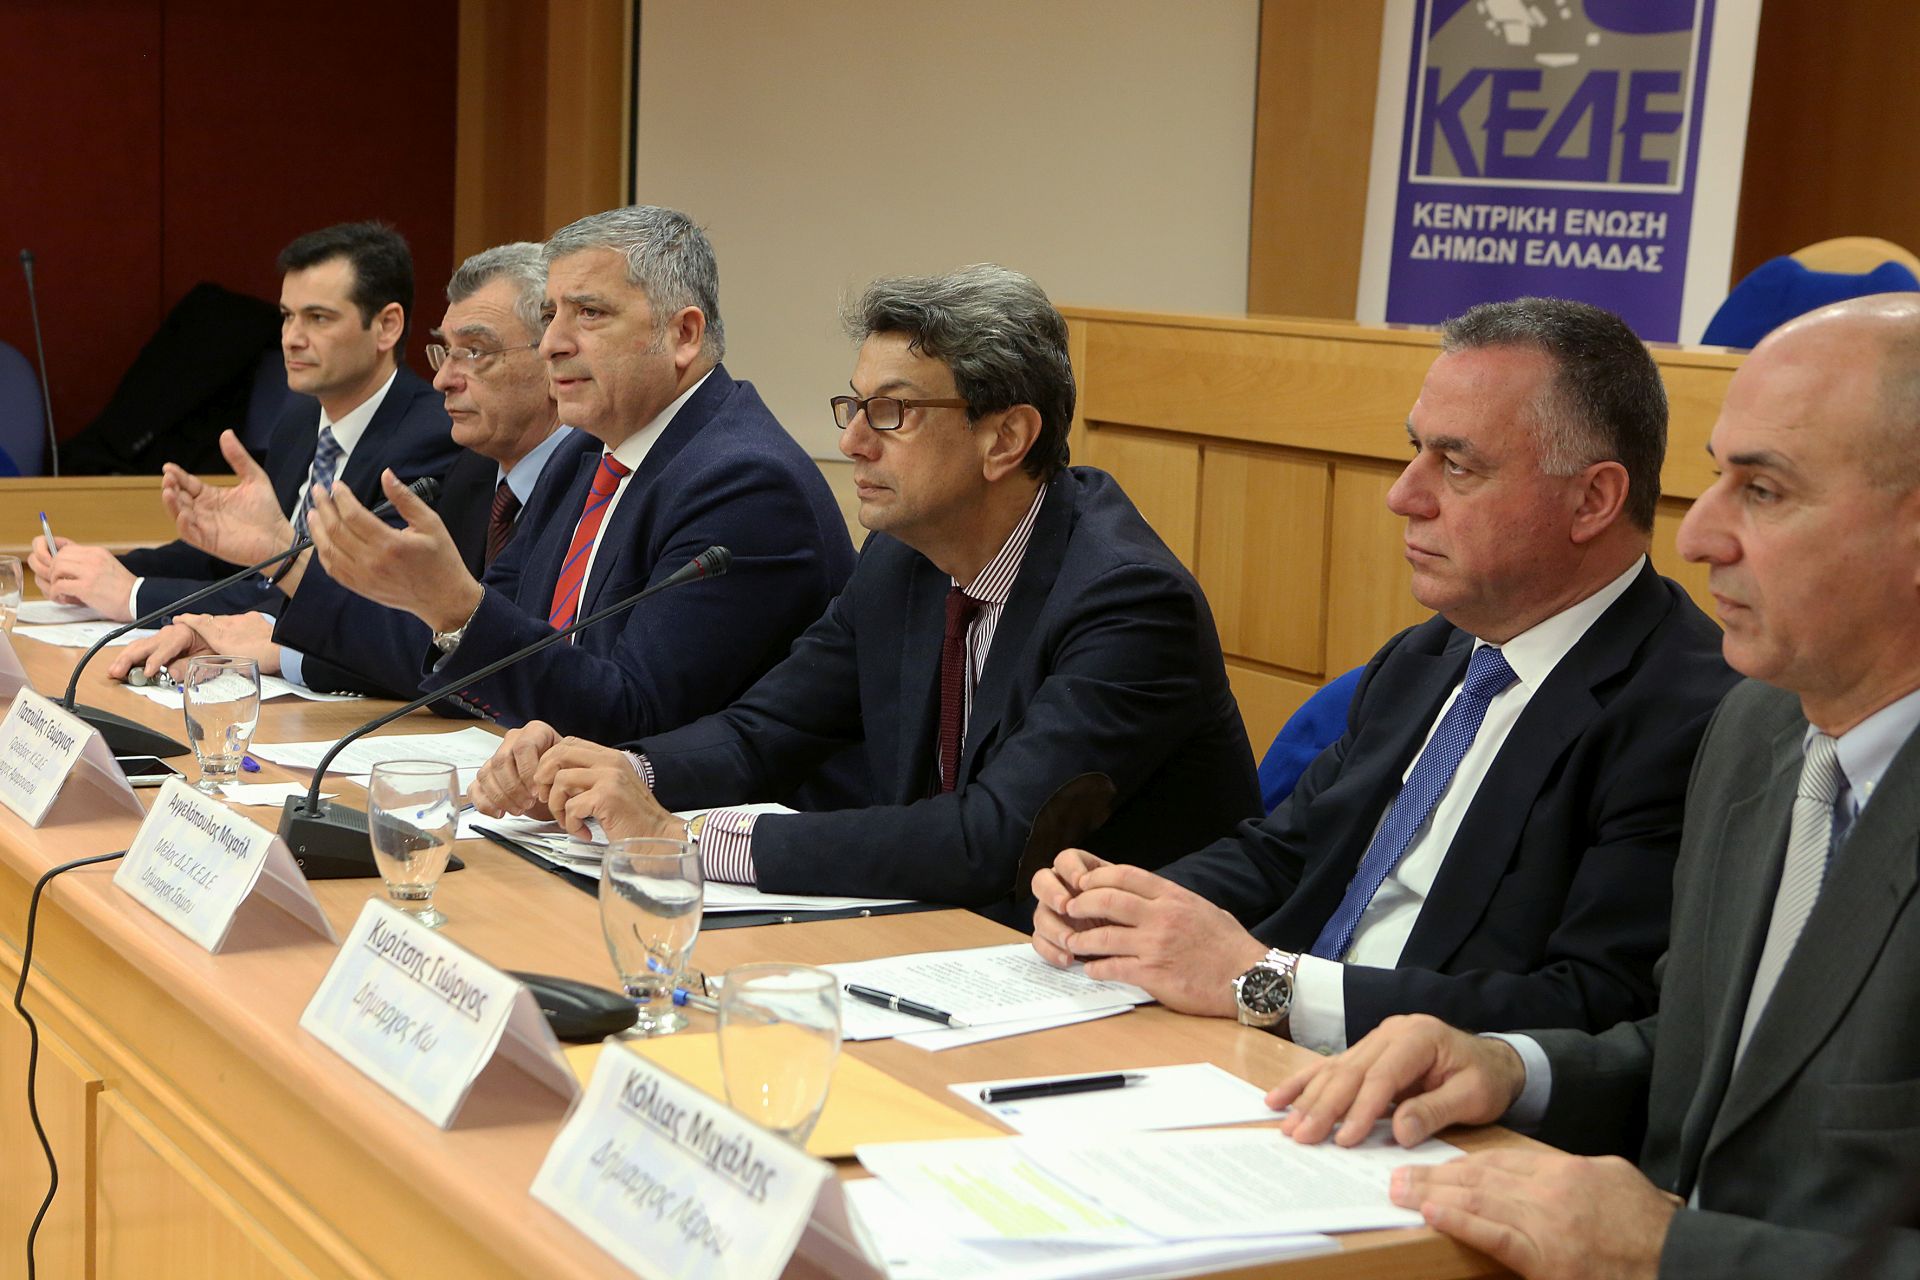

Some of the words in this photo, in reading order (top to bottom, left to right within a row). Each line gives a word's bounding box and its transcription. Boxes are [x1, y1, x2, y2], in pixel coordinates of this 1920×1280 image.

[1416, 66, 1685, 185] ΚΕΔΕ
[1410, 234, 1517, 265] ΔΗΜΩΝ
[1524, 240, 1664, 272] ΕΛΛΑΔΑΣ
[1412, 201, 1556, 235] ΚΕΝΤΡΙΚΗ
[1564, 208, 1668, 239] ΕΝΩΣΗ
[16, 700, 48, 737] Πατούλης
[44, 719, 75, 757] Γεώργιος
[154, 838, 179, 866] Μέλος
[168, 792, 220, 843] Αγγελόπουλος
[217, 825, 251, 859] Μιχαήλ
[142, 866, 174, 902] Δήμαρχος
[171, 887, 196, 914] Σάμου
[368, 917, 431, 984] Κυρίτσης
[428, 955, 489, 1022] Γιώργος
[352, 981, 417, 1044] Δήμαρχος
[411, 1024, 442, 1053] Κω
[620, 1067, 688, 1143] Κόλιας
[684, 1109, 778, 1207] Μιχάλης
[590, 1139, 676, 1220] Δήμαρχος
